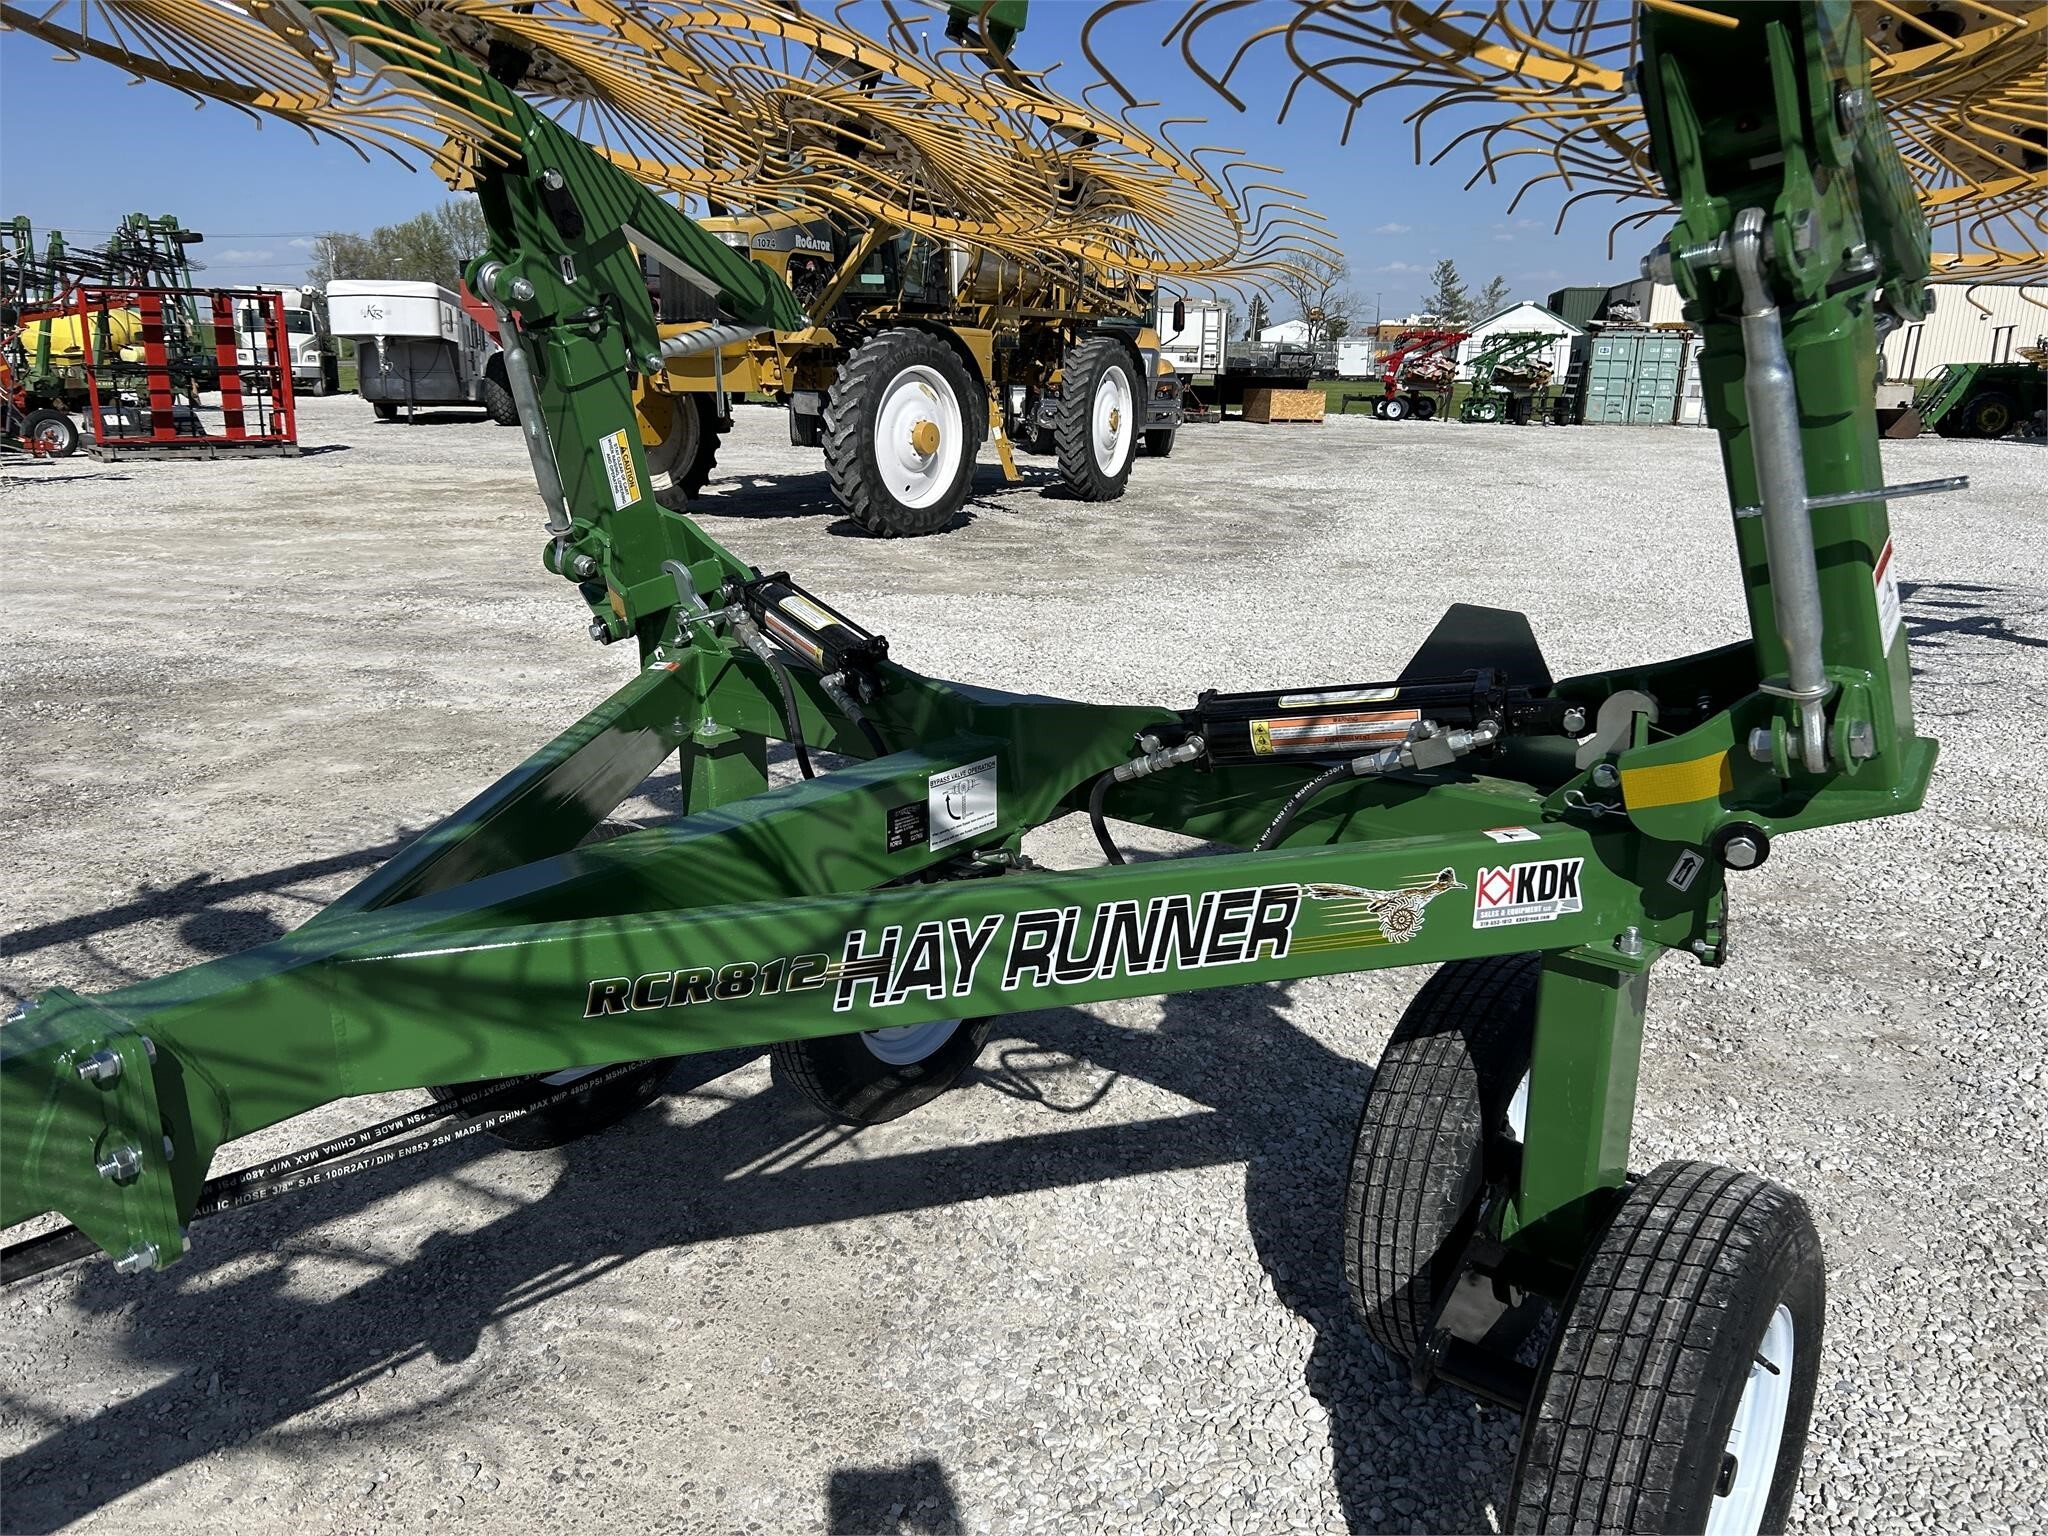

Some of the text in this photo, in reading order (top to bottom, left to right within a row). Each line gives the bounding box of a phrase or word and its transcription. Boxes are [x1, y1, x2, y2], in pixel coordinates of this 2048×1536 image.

[757, 238, 776, 249] 1074
[622, 454, 635, 488] CAUTION
[930, 761, 996, 786] BYPASS VALVE OPERATION
[1272, 810, 1285, 826] 4800
[1516, 861, 1581, 904] KDK
[1480, 909, 1500, 918] SALES
[1507, 906, 1542, 915] EQUIPMENT
[583, 883, 1303, 1019] RCR812 HAY RUNNER
[360, 1131, 372, 1143] IN
[375, 1120, 404, 1138] MADE
[235, 1189, 267, 1206] HOSE
[298, 1173, 321, 1188] SAE
[398, 1141, 430, 1159] EN853
[432, 1133, 451, 1148] 2SN
[454, 1123, 482, 1140] MADE
[485, 1117, 496, 1129] IN
[499, 1107, 527, 1124] CHINA
[528, 1098, 549, 1113] MAX
[551, 1090, 568, 1104] W/P
[570, 1083, 589, 1096] 4800
[589, 1077, 603, 1090] PSI
[323, 1137, 356, 1155] CHINA
[270, 1159, 291, 1173] W/P
[295, 1150, 319, 1165] MAX
